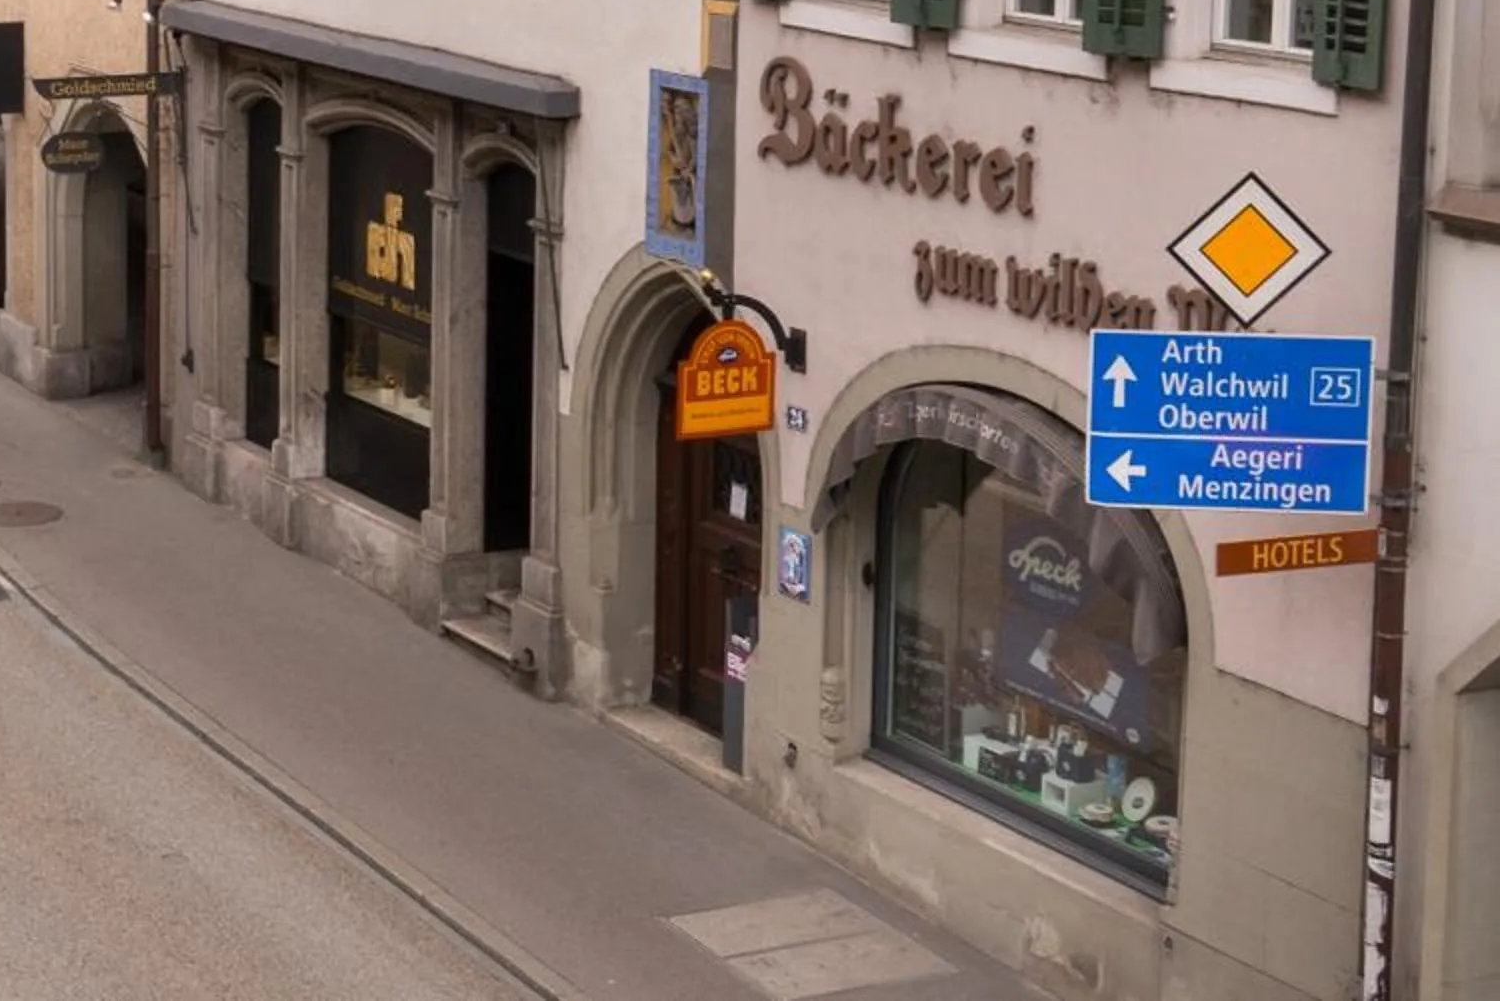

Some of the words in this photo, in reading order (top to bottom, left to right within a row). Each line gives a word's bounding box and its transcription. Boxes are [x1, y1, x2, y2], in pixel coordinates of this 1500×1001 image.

[50, 77, 156, 97] Goldschmied
[758, 55, 1036, 218] Bäckerei
[912, 239, 999, 305] zum
[1005, 252, 1157, 332] wilden
[1160, 339, 1223, 365] Arth
[696, 365, 759, 397] BECK
[1160, 373, 1289, 400] Walchwil
[1317, 374, 1353, 400] 25
[1158, 403, 1268, 431] Oberwil
[1210, 444, 1304, 475] Aegeri
[1178, 474, 1332, 507] Menzingen
[1252, 536, 1344, 570] HOTELS
